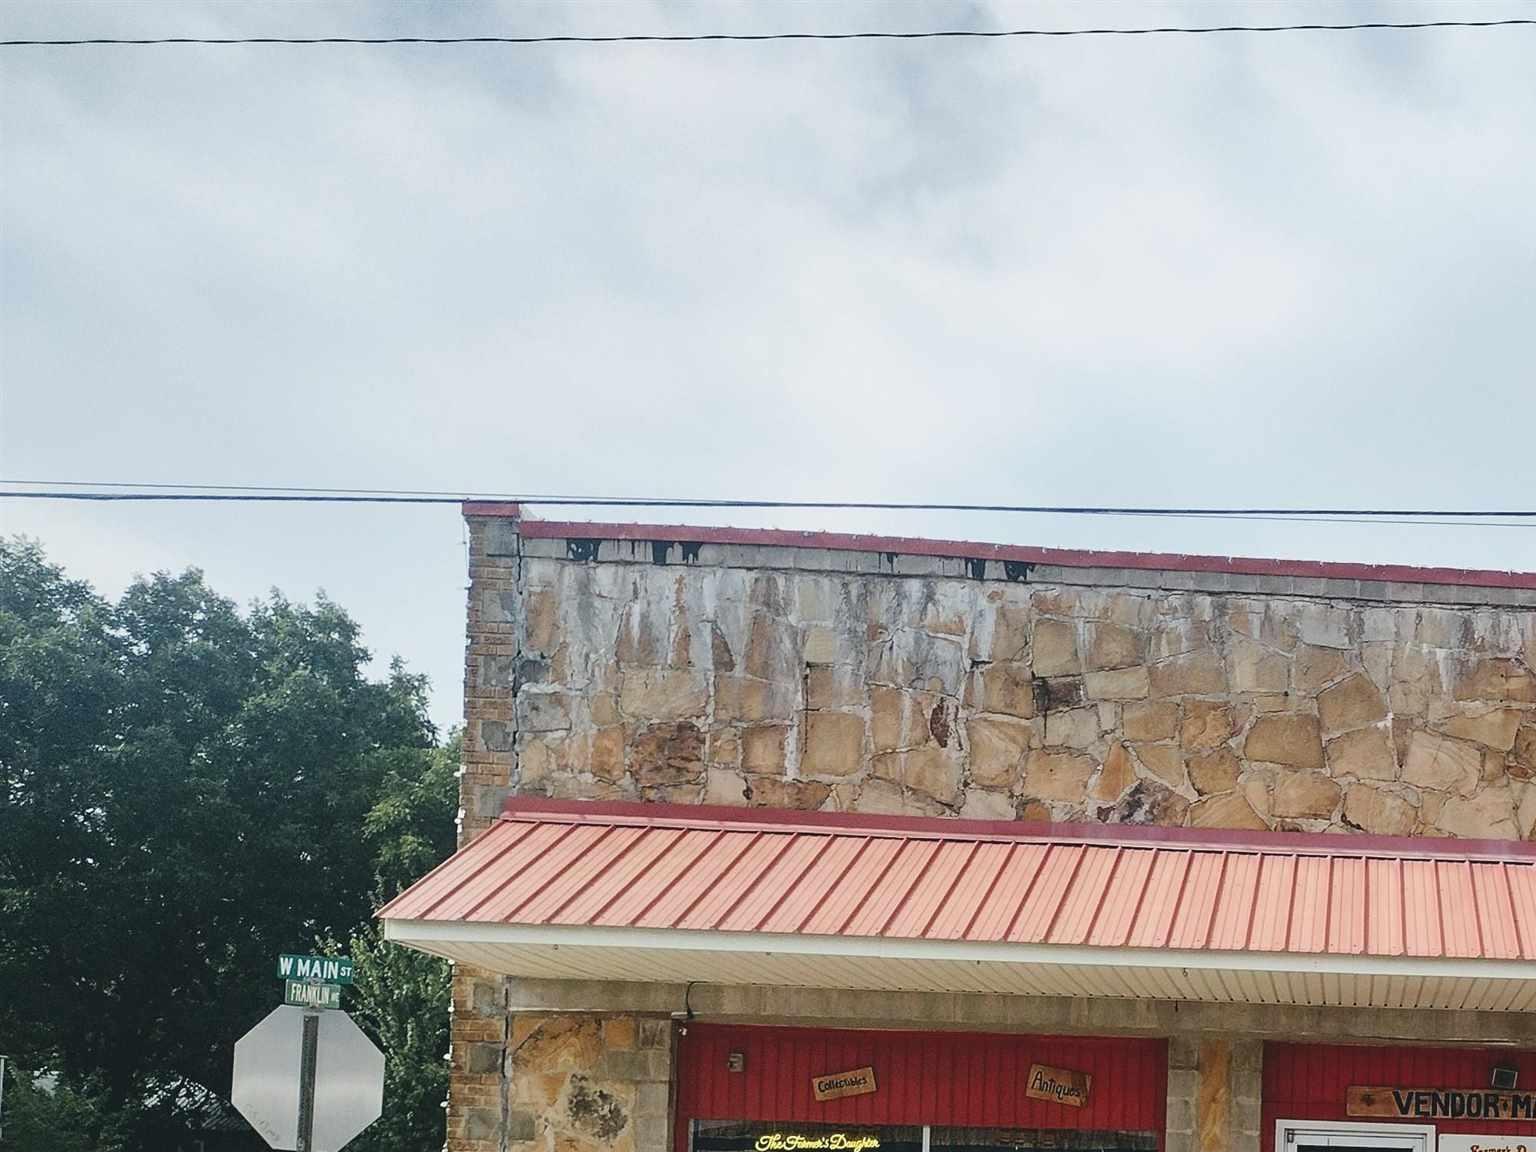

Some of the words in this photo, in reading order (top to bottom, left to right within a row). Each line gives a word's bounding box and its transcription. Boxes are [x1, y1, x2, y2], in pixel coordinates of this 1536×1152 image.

[280, 957, 294, 976] W
[296, 958, 339, 979] MAIN
[340, 966, 352, 977] ST
[291, 983, 330, 1004] FRANKLIN
[1031, 1071, 1081, 1100] Antiques
[1391, 1090, 1500, 1118] VENDOR
[755, 1133, 784, 1152] The
[783, 1134, 830, 1151] Farmer's
